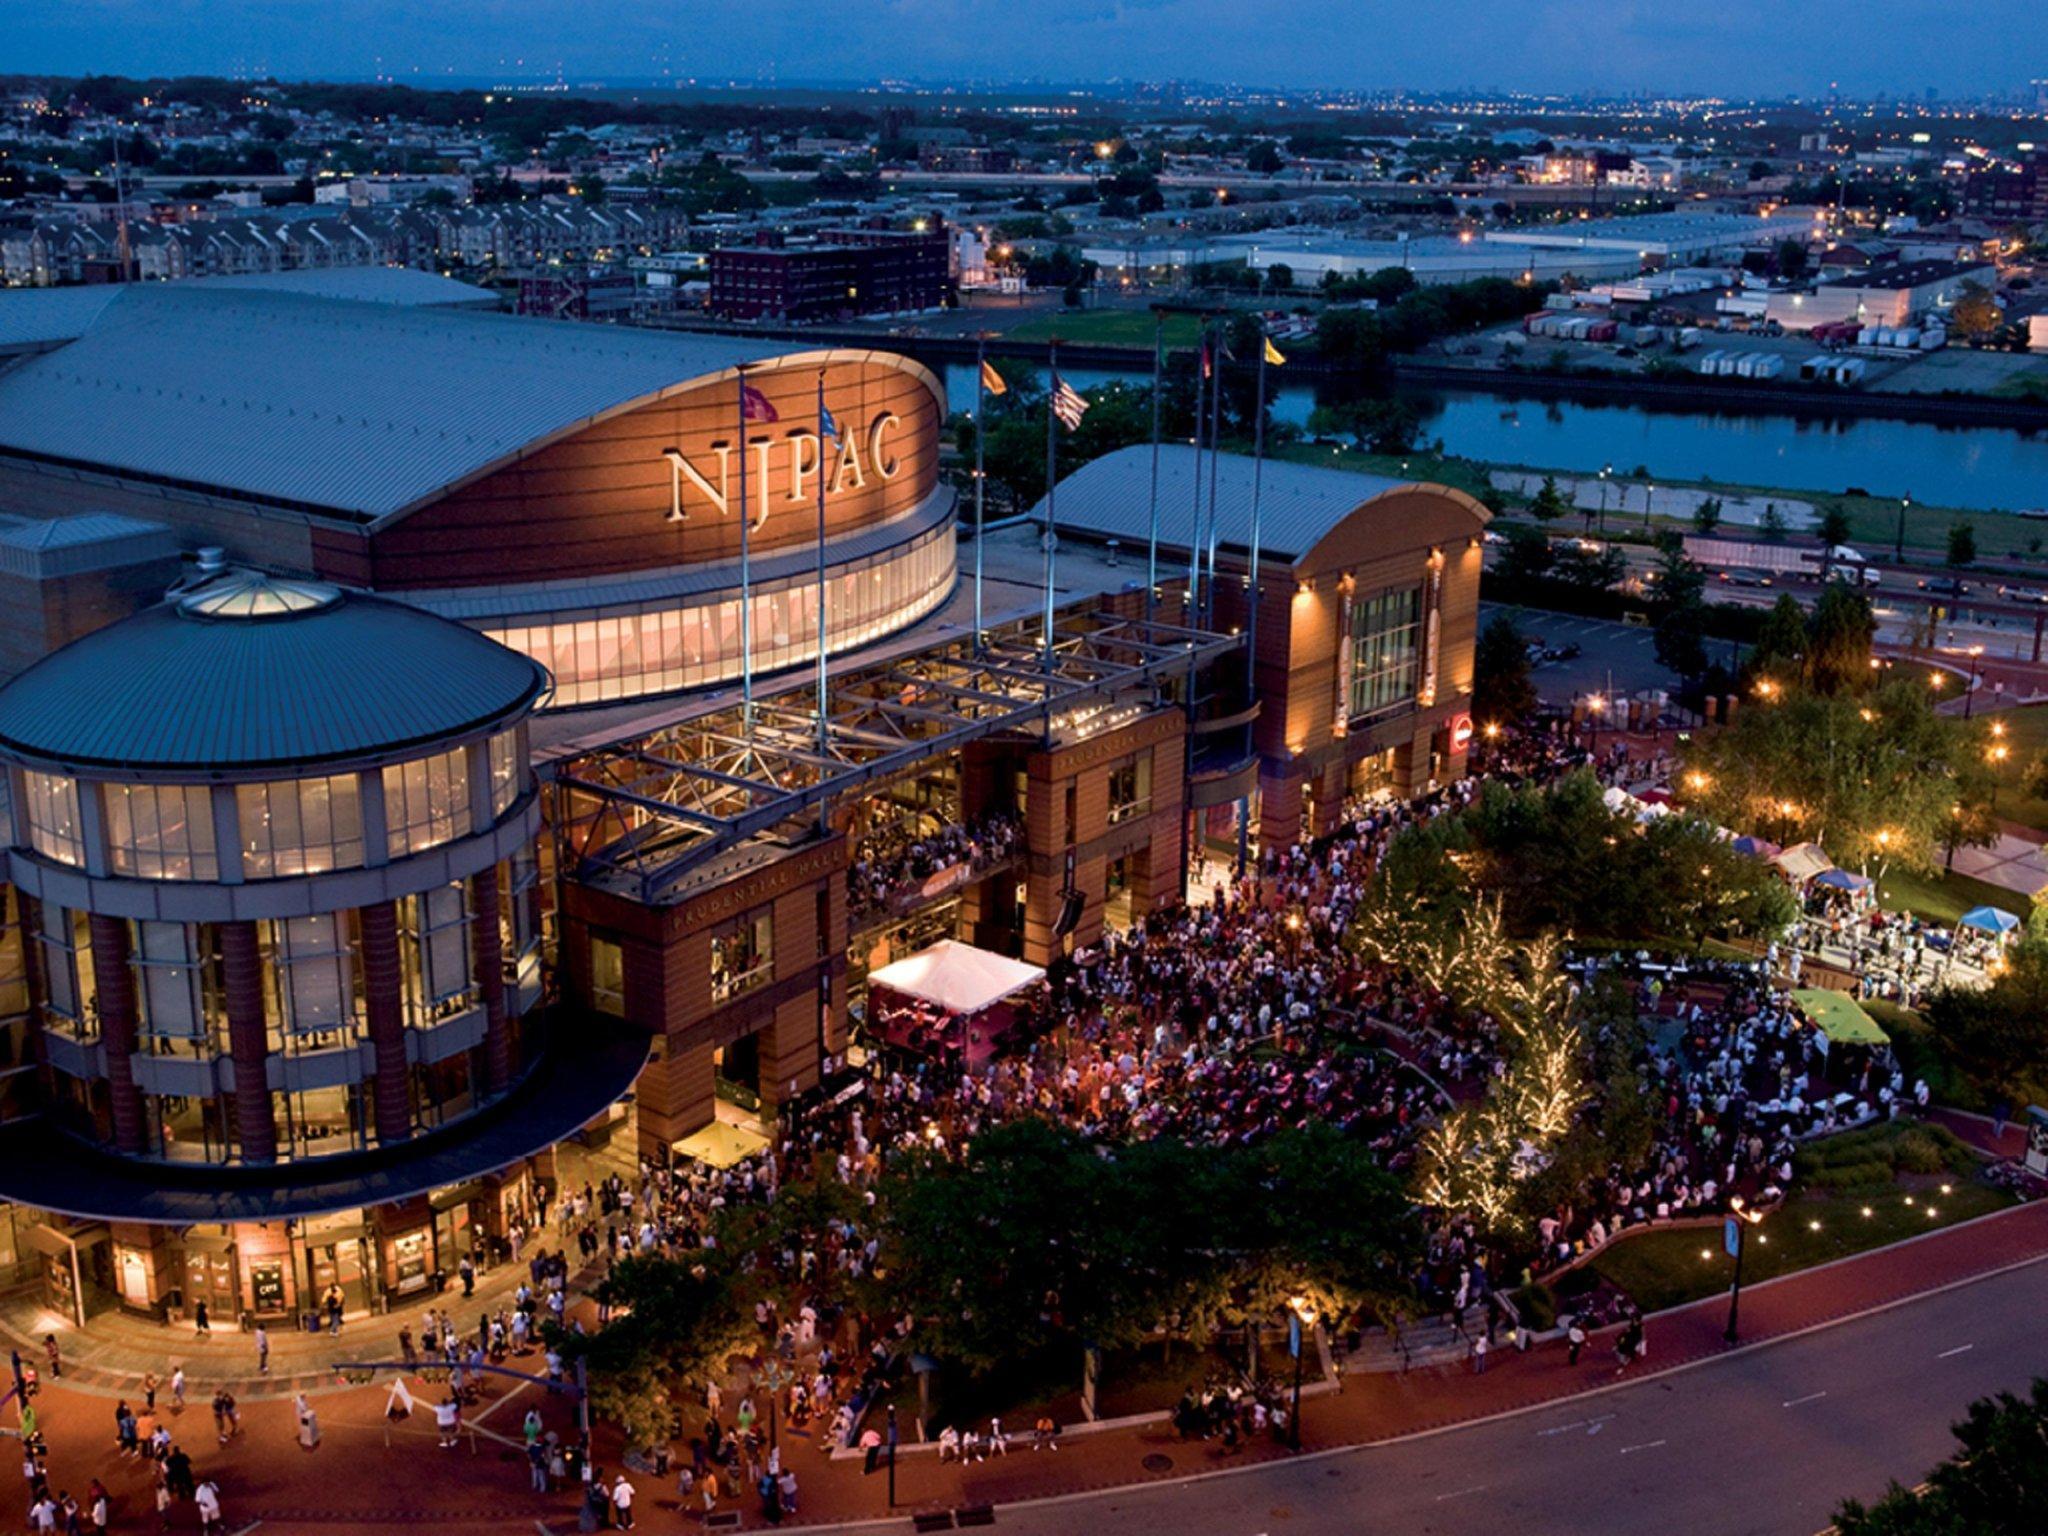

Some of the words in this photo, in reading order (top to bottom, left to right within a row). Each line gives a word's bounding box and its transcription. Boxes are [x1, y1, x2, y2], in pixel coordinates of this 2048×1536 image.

[663, 414, 900, 533] NJPAC
[672, 871, 789, 930] PRUDENTIAL
[797, 850, 841, 875] HALL
